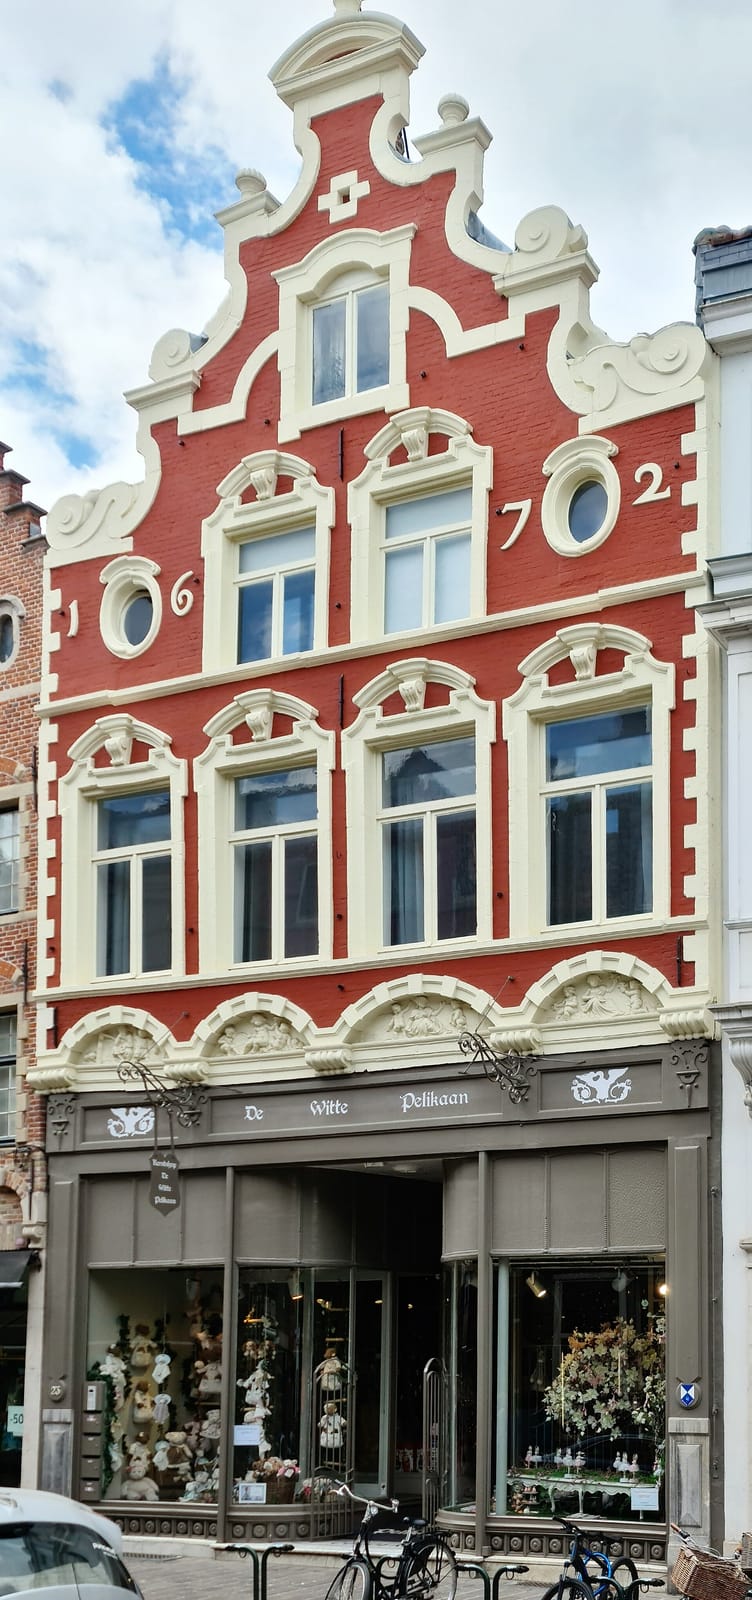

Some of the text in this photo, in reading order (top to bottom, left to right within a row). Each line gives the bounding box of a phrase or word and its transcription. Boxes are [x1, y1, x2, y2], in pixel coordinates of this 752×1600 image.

[170, 570, 194, 617] 6
[500, 498, 532, 550] 7
[631, 462, 671, 506] 2
[244, 1091, 469, 1121] De Witte Pelikaan
